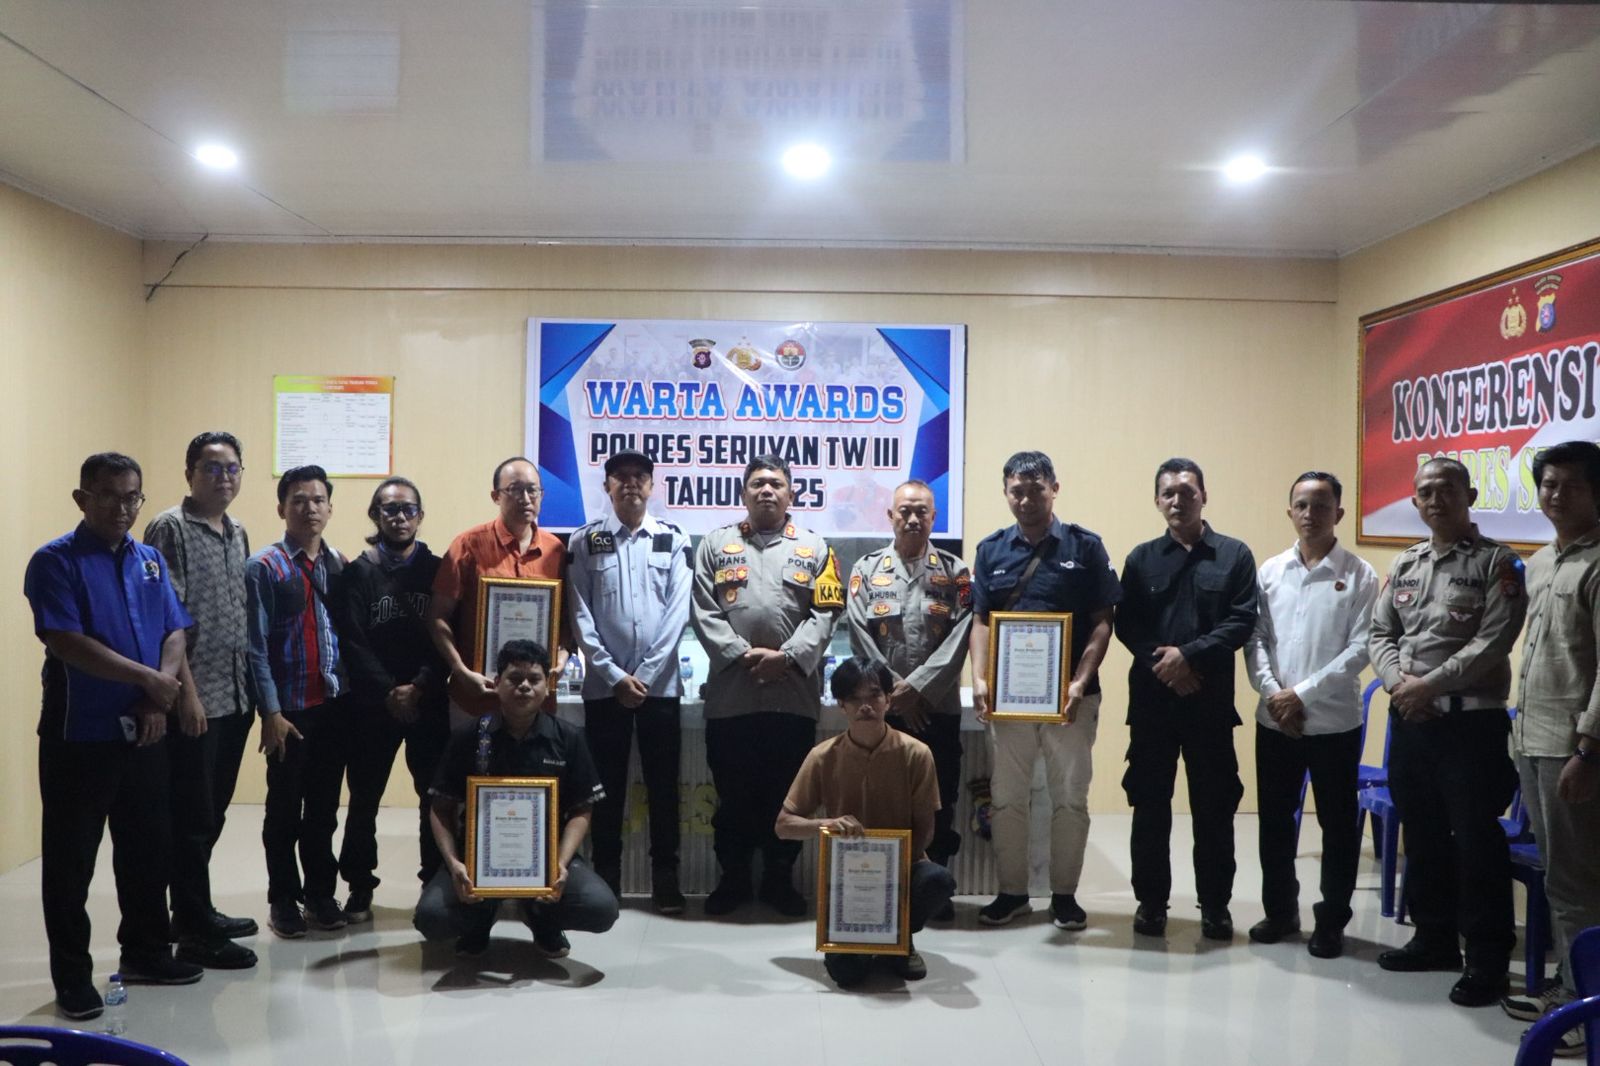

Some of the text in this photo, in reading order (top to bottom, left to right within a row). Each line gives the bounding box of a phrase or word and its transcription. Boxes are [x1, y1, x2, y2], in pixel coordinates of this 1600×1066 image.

[586, 380, 905, 420] WARTA AWARDS
[1393, 344, 1599, 440] KONFERENSI
[699, 434, 819, 466] SERUYAN
[826, 436, 868, 467] TW
[873, 437, 899, 468] III
[792, 477, 824, 508] 25
[719, 556, 746, 566] HANS
[788, 558, 817, 573] POLRI
